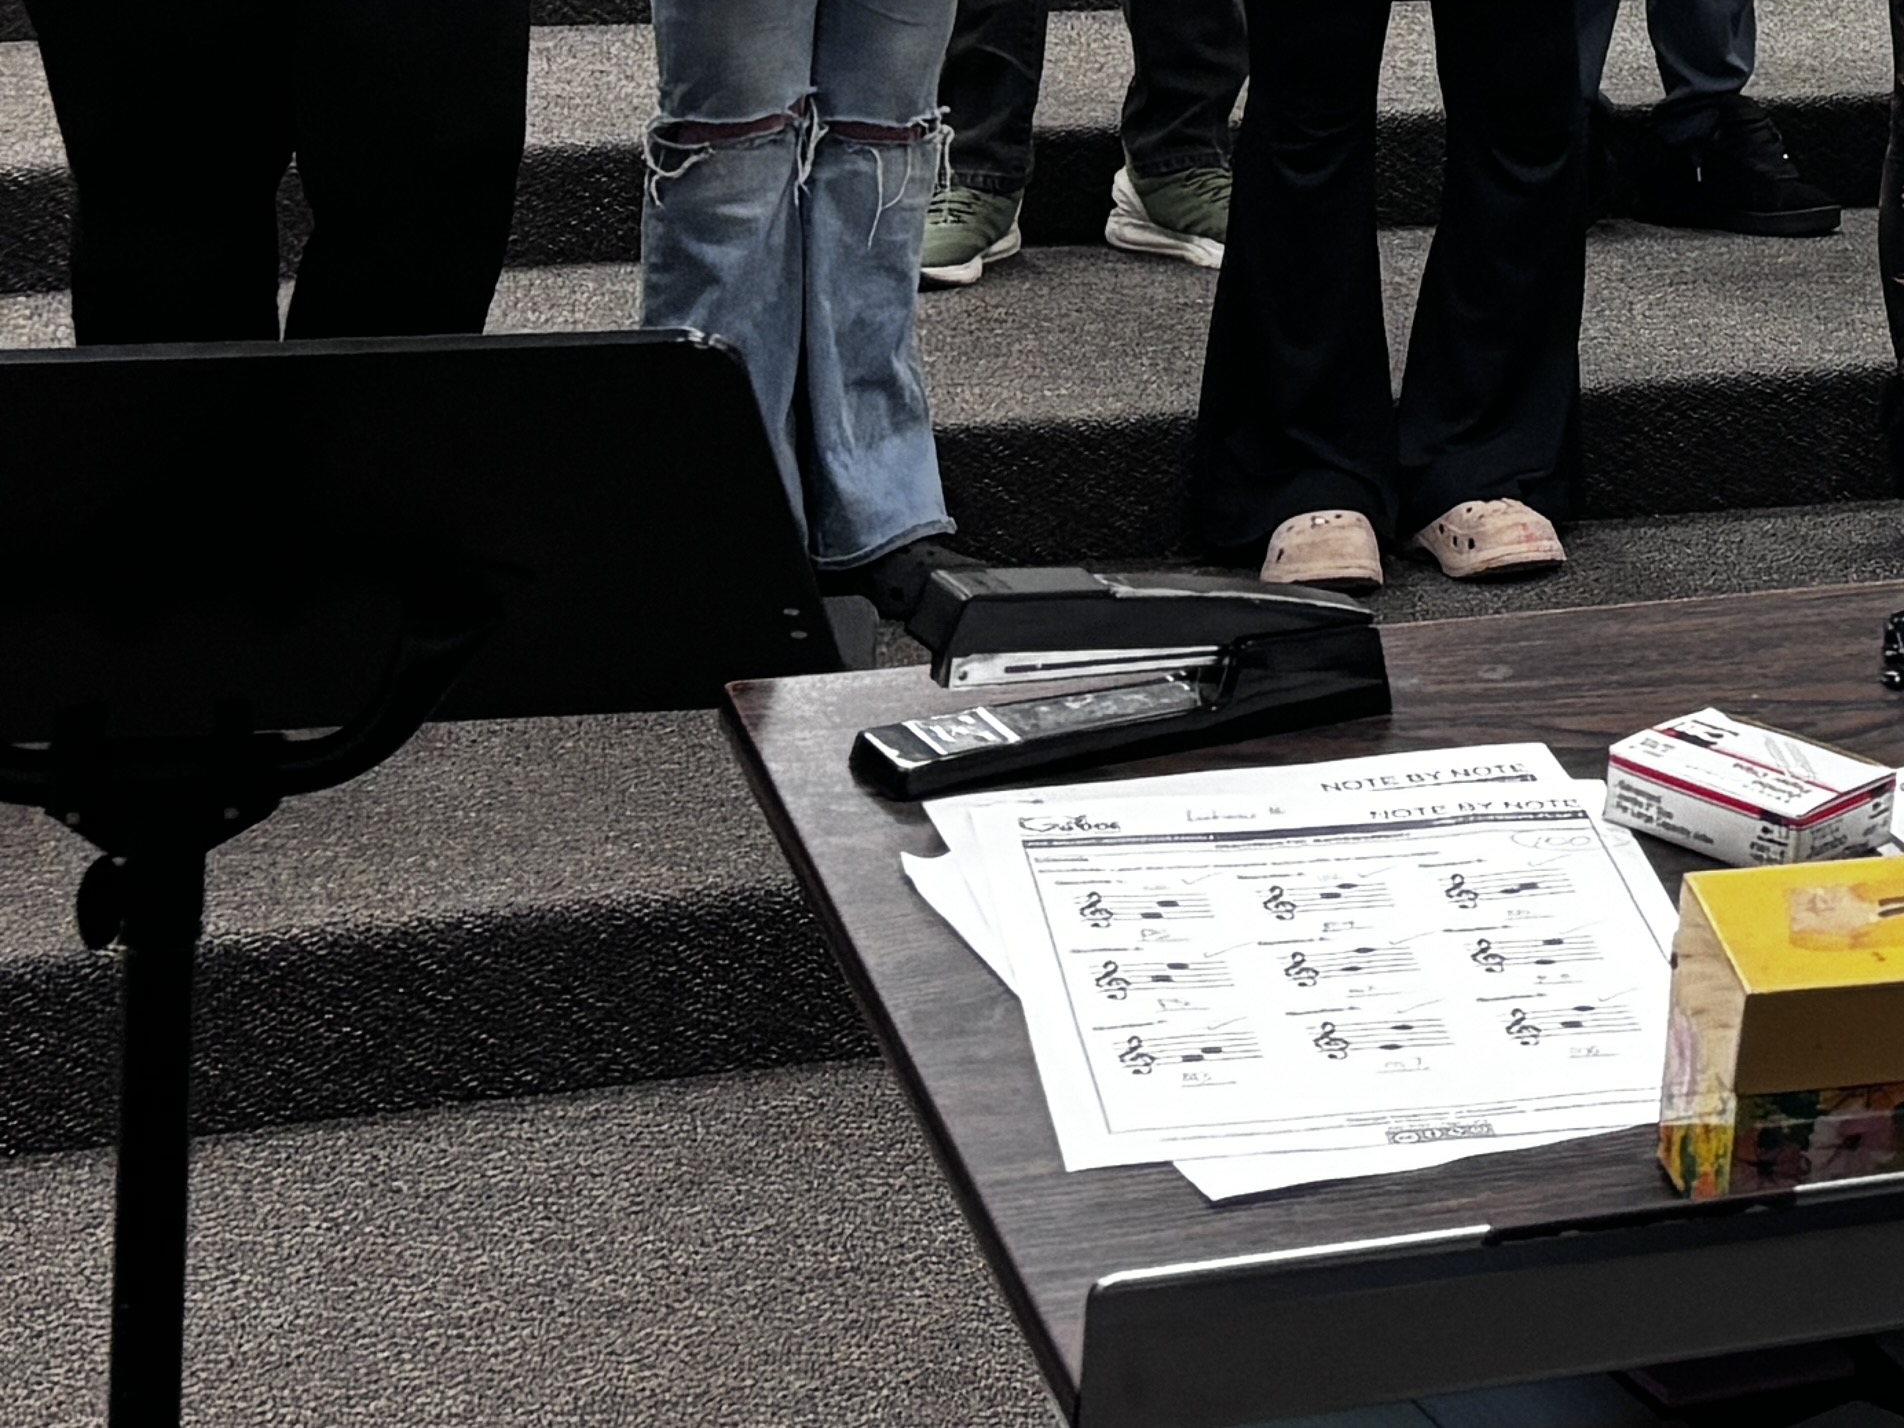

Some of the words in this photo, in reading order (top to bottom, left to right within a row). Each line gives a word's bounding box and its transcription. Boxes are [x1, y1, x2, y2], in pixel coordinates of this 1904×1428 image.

[1320, 774, 1400, 793] NOTE
[1406, 770, 1440, 783] BY
[1450, 763, 1530, 778] NOTE
[1369, 804, 1446, 820] NOTE
[1458, 801, 1493, 812] BY
[1503, 798, 1581, 810] NOTE
